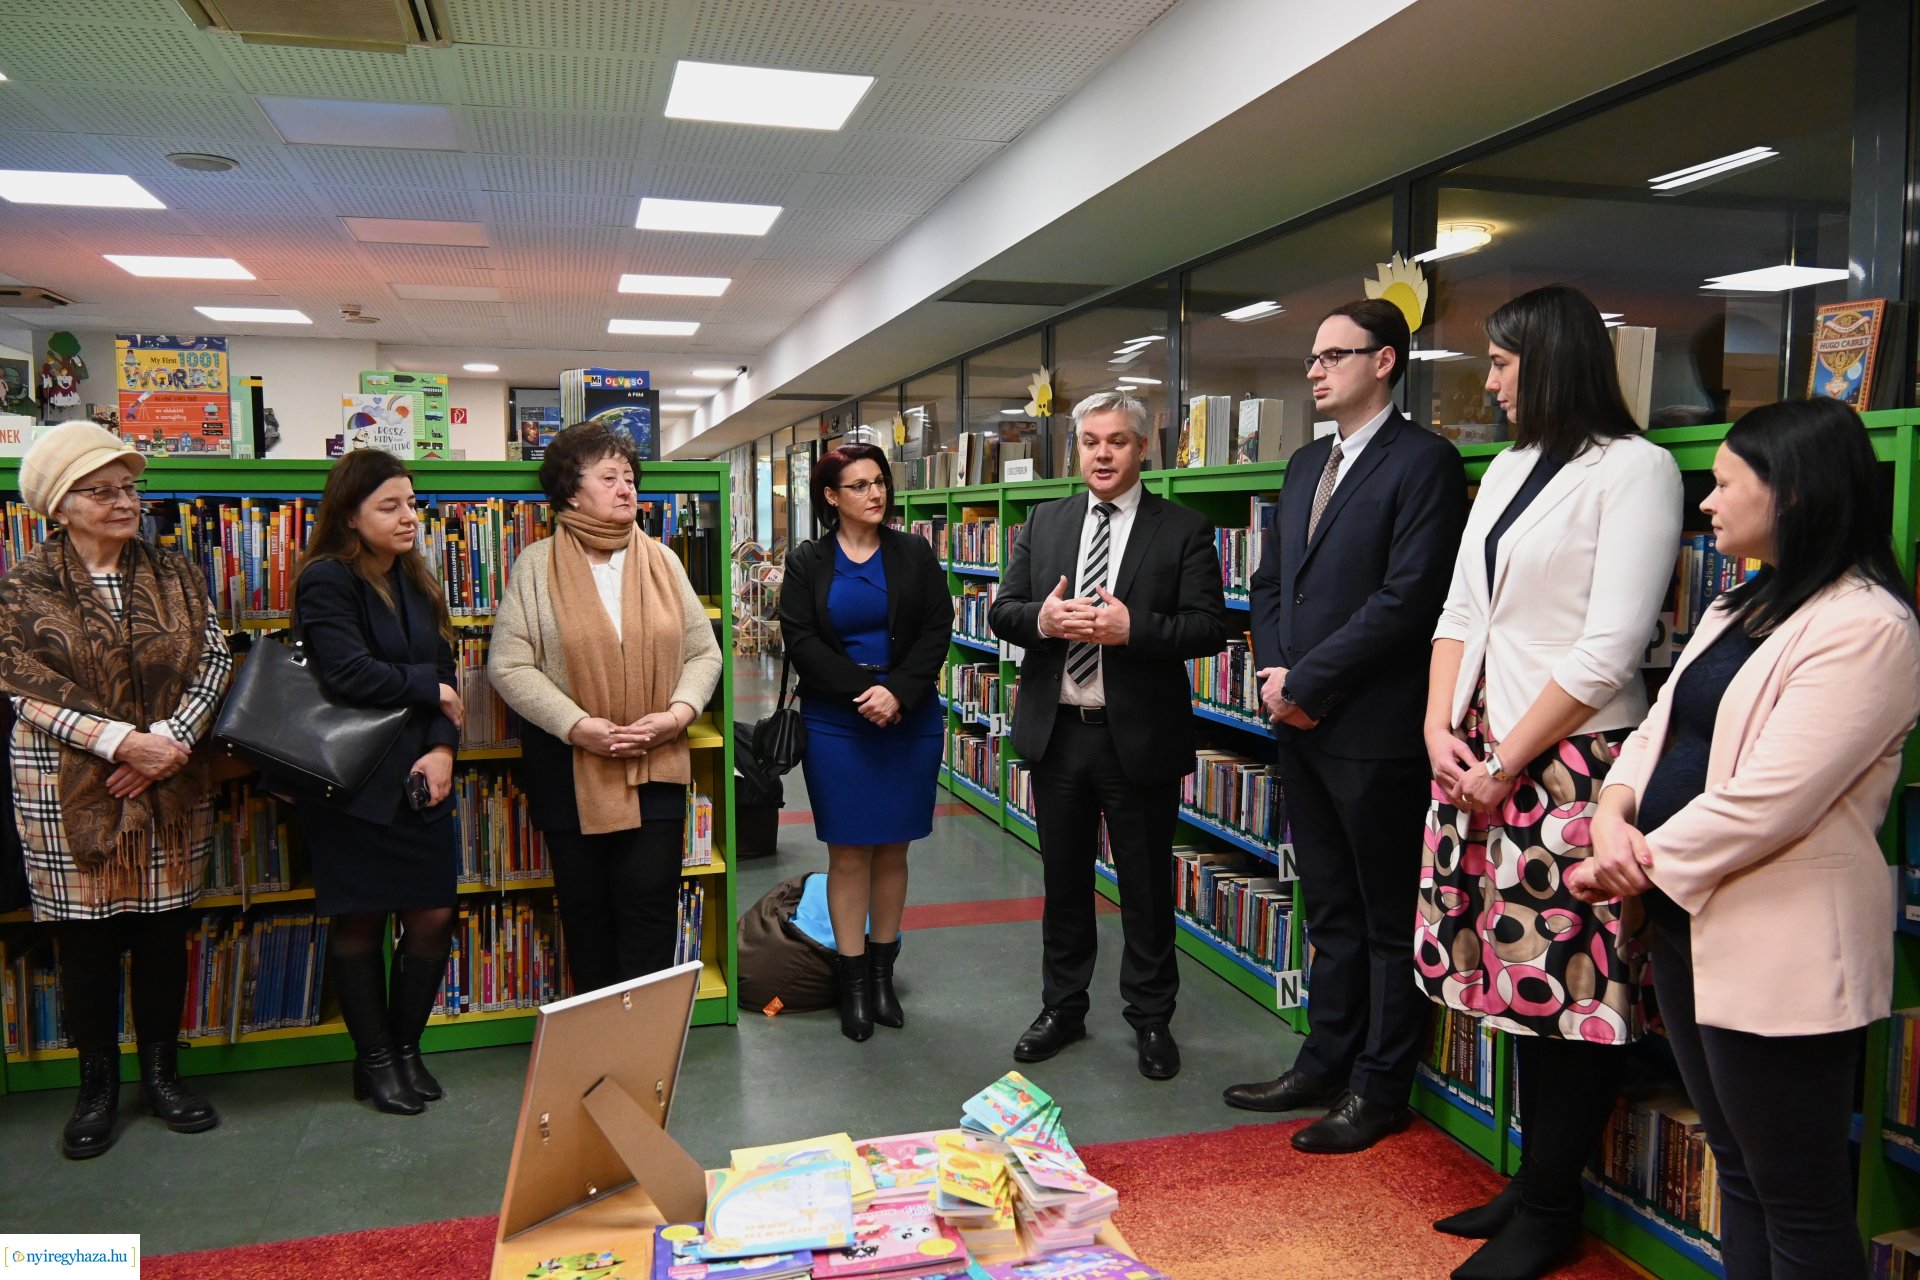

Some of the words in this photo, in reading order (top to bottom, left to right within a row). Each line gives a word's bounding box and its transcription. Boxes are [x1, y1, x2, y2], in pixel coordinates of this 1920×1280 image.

[1820, 342, 1840, 350] HUGO
[1841, 337, 1869, 348] CABRET
[178, 352, 220, 368] 1001
[123, 366, 222, 390] WORDS
[591, 375, 601, 384] Mi
[605, 376, 643, 388] OLVASÓ
[965, 704, 976, 721] H
[995, 716, 1002, 734] J
[1281, 975, 1298, 1006] N
